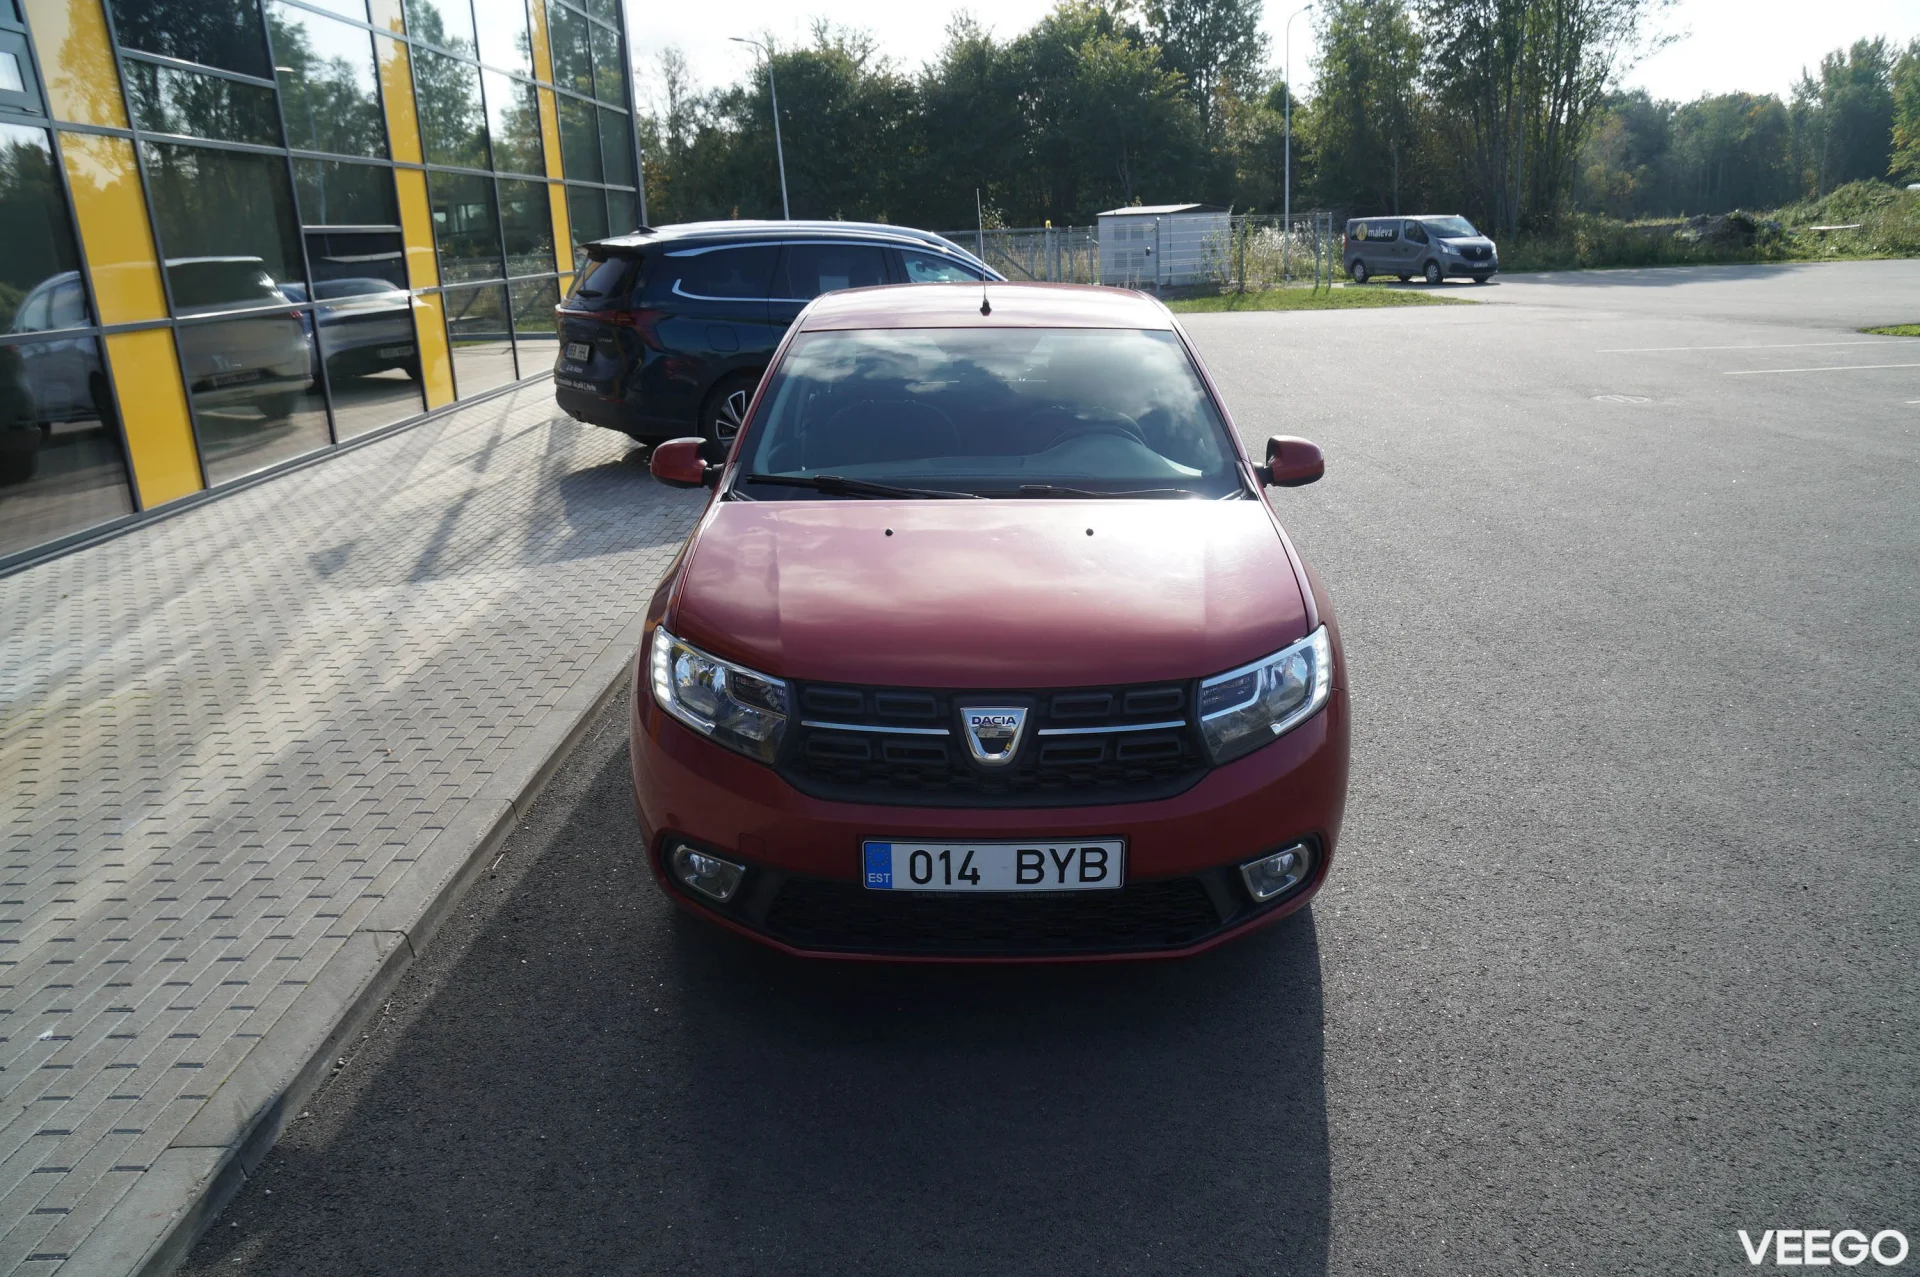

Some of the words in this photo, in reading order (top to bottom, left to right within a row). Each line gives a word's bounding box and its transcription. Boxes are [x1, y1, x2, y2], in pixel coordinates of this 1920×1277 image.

[1368, 226, 1393, 237] maleva
[971, 716, 1016, 725] DACIA
[909, 849, 981, 885] 014
[1016, 847, 1109, 885] BYB
[868, 873, 891, 883] EST
